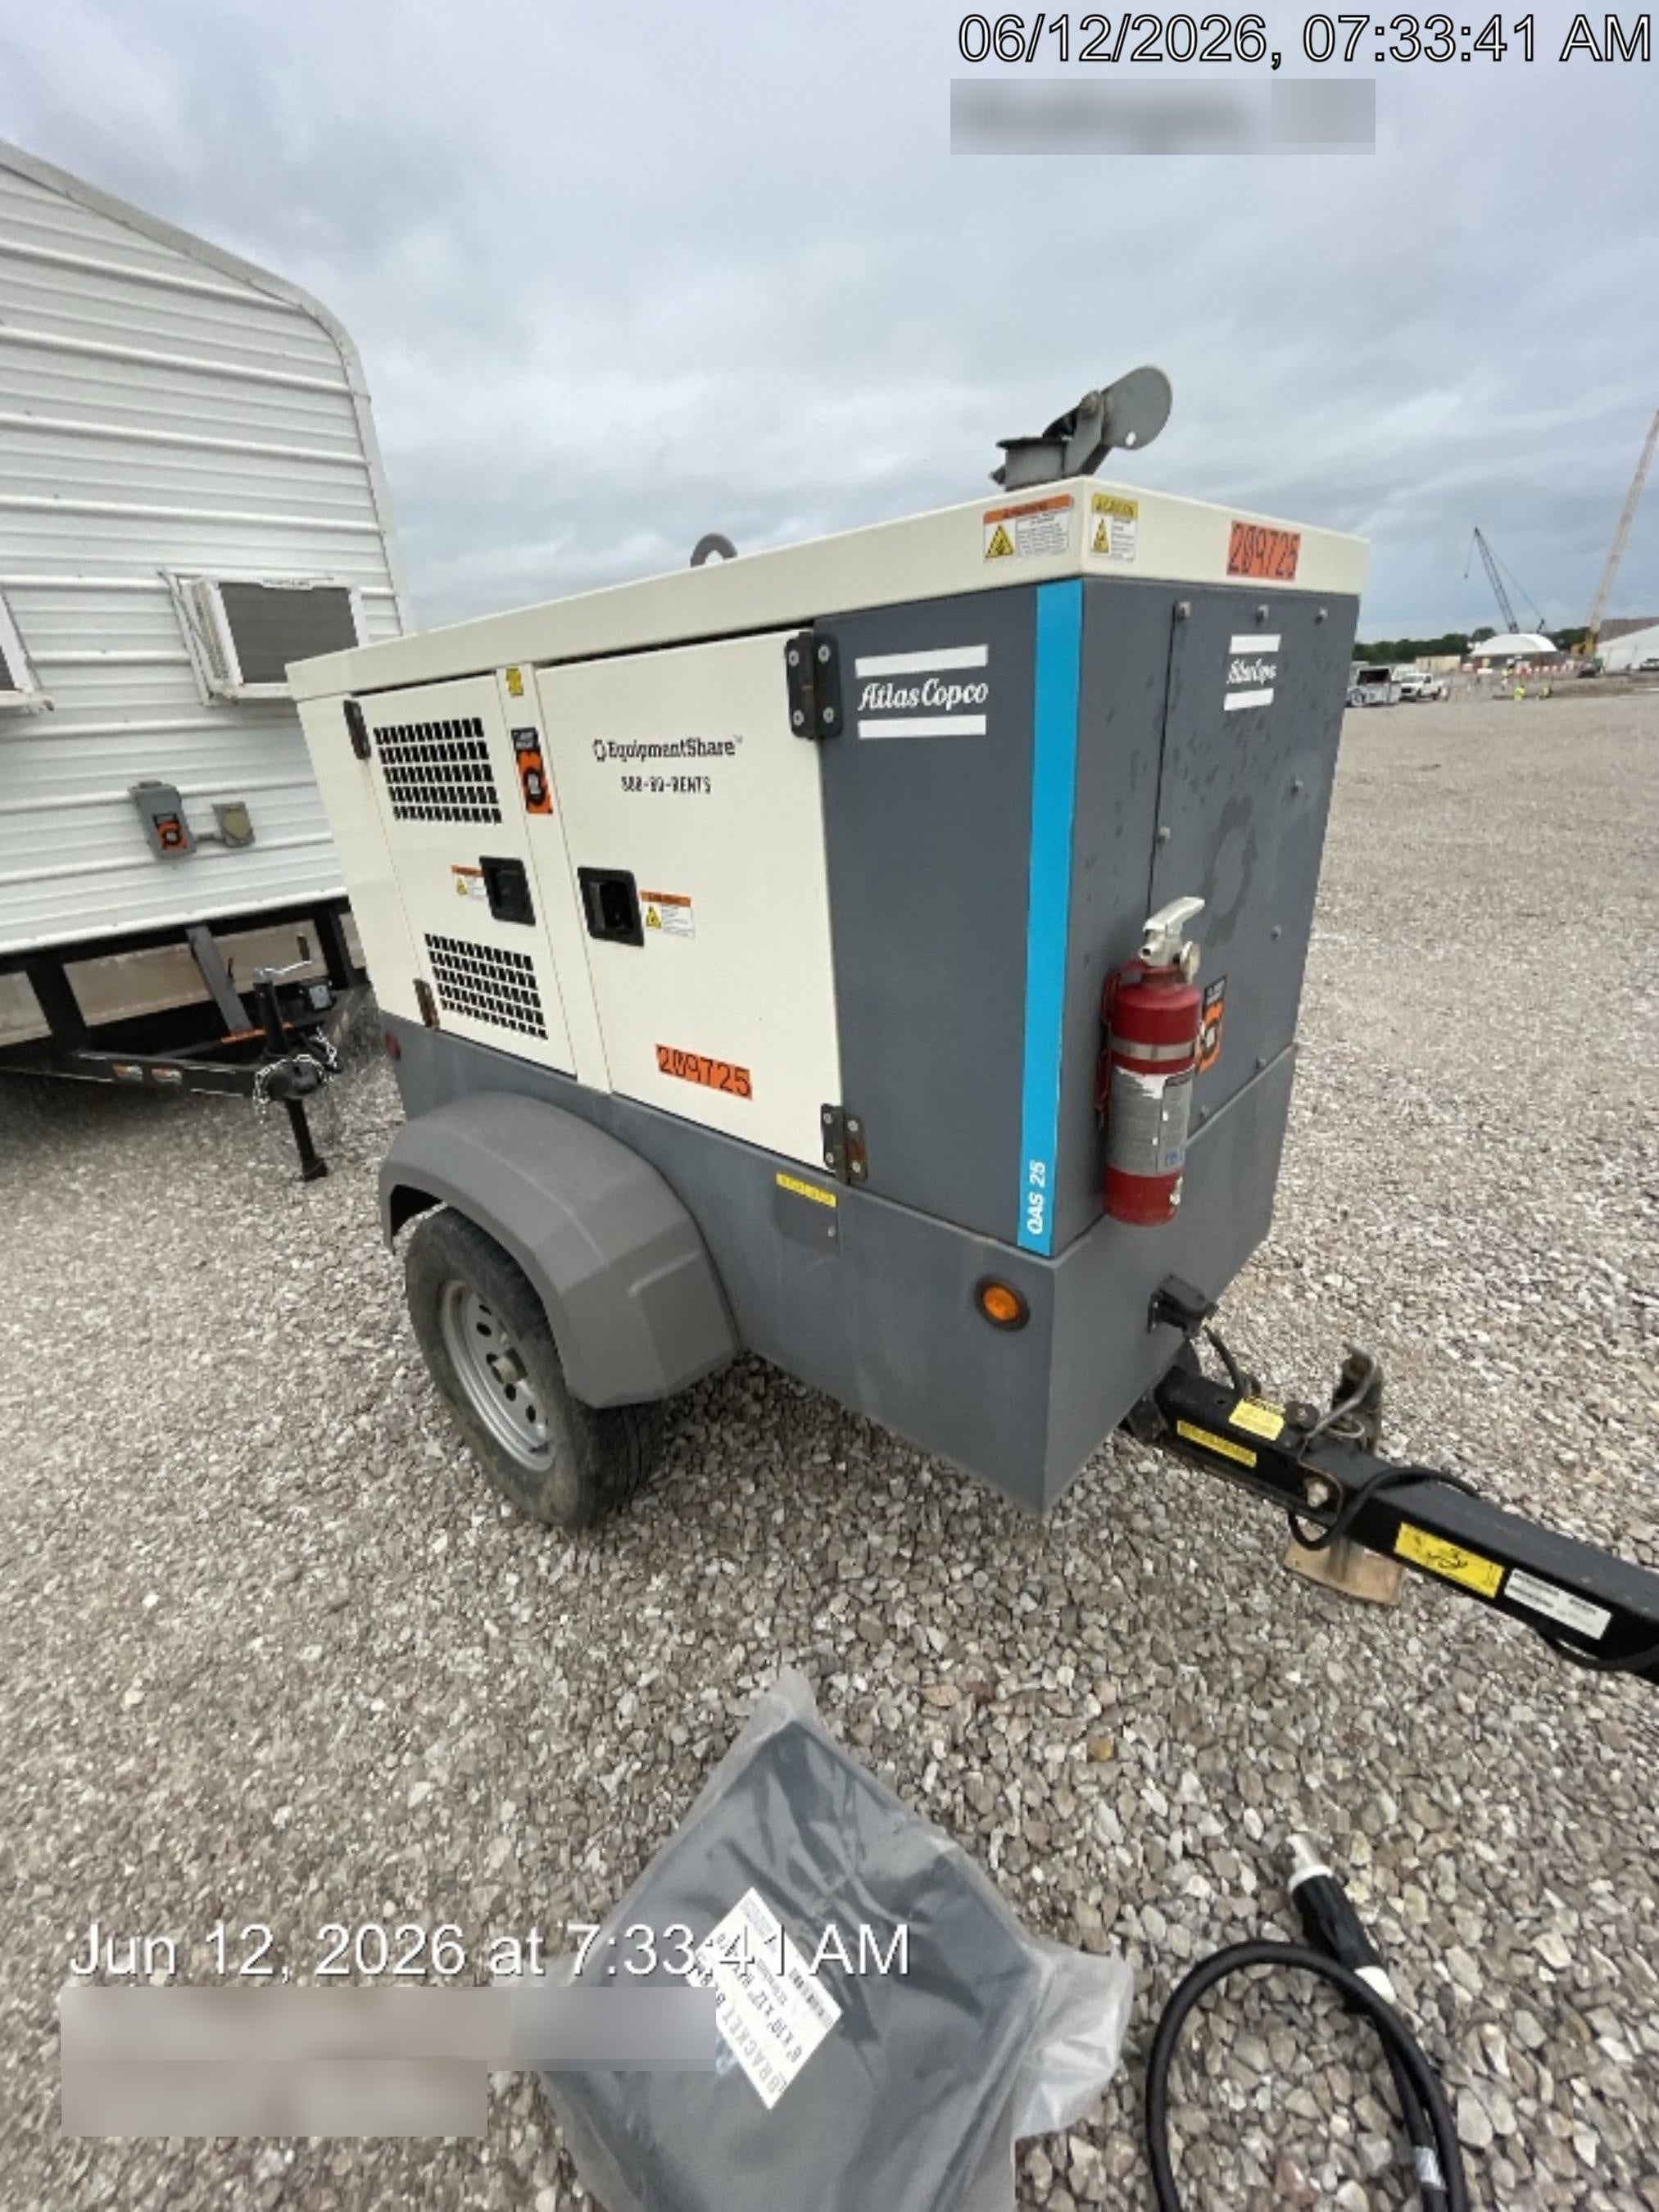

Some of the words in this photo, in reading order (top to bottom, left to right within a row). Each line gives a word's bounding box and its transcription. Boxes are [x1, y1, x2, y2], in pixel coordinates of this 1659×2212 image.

[857, 682, 919, 711] Atlas
[921, 678, 989, 711] Copco
[607, 737, 735, 763] EquipmentShare
[658, 1046, 750, 1097] 209725
